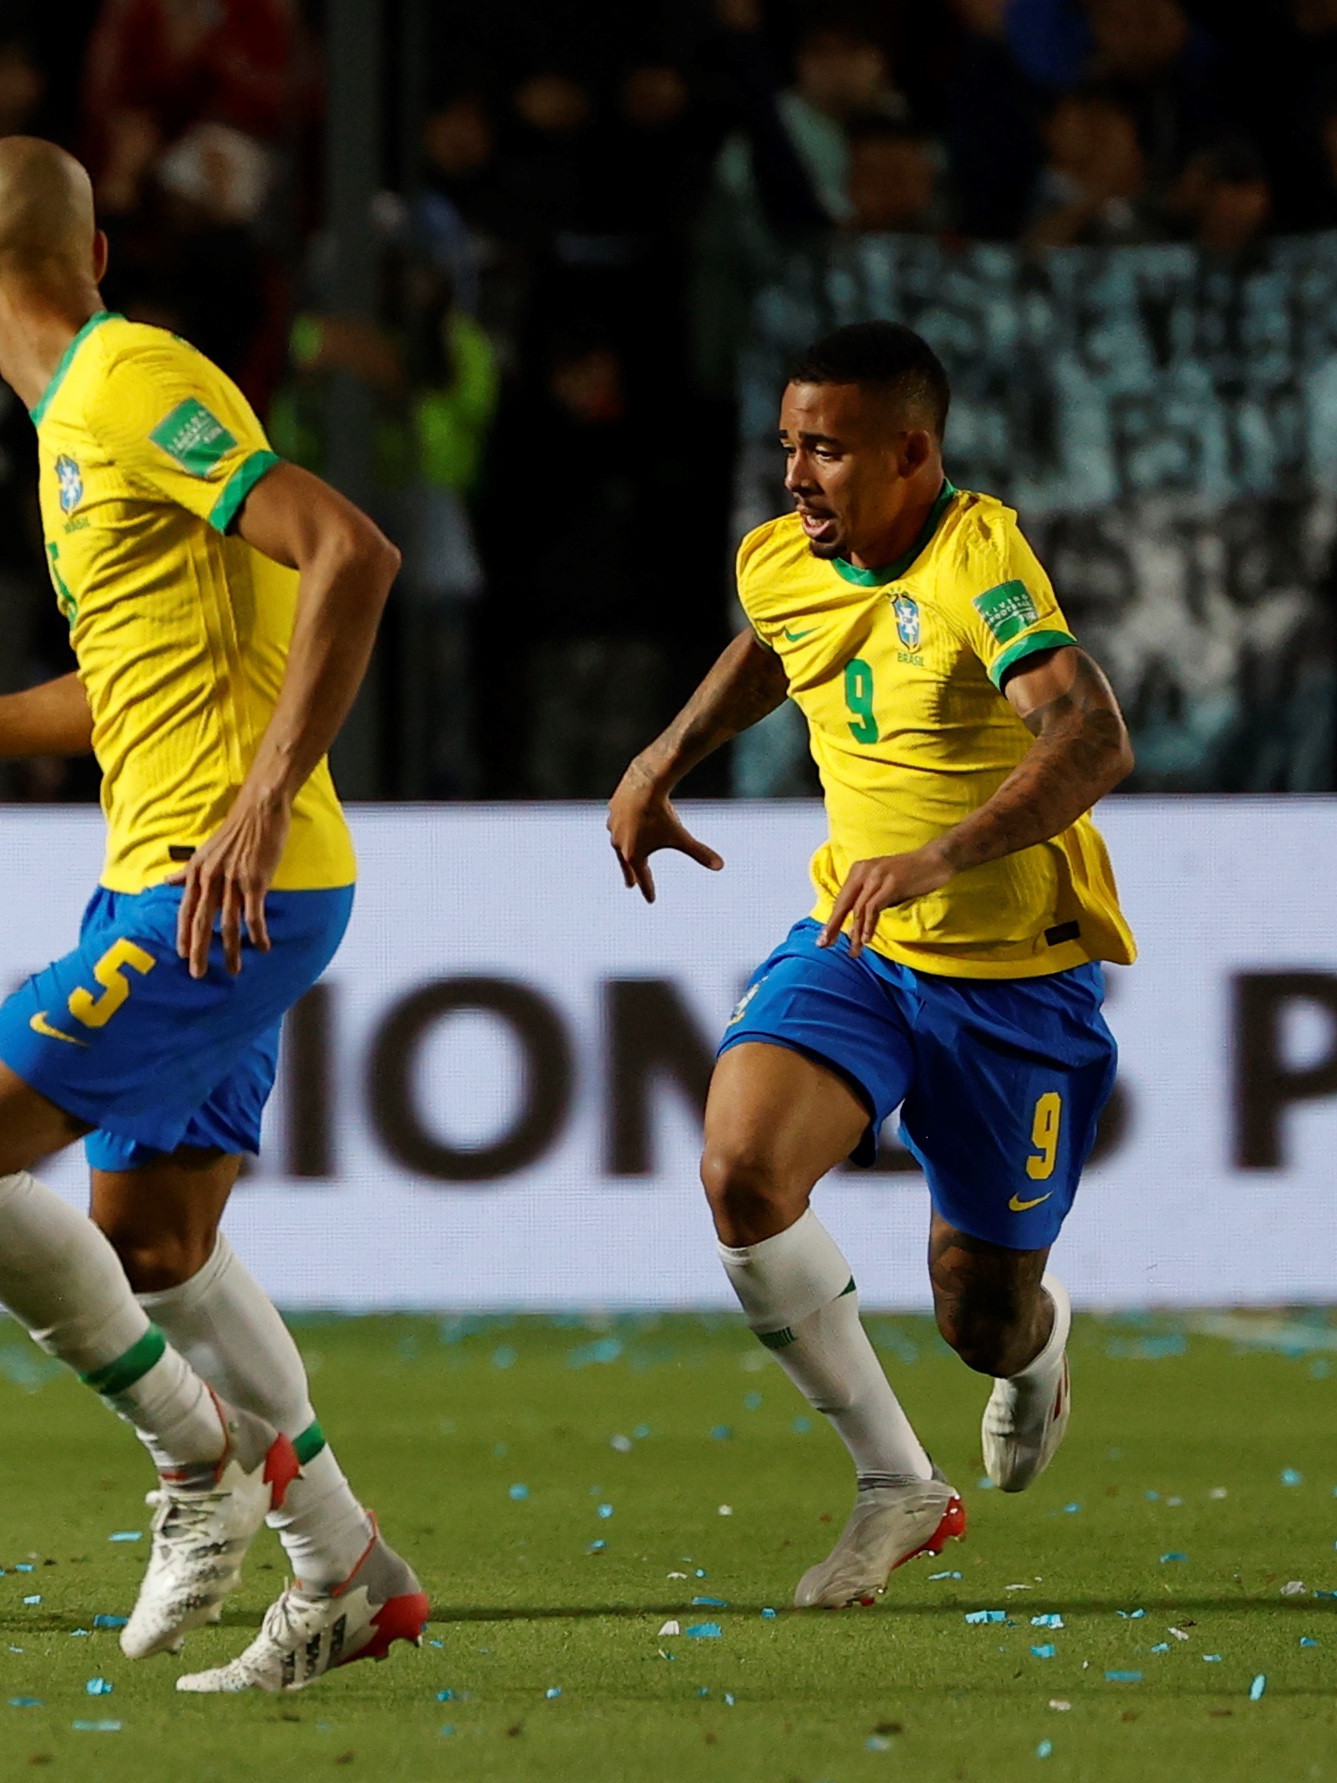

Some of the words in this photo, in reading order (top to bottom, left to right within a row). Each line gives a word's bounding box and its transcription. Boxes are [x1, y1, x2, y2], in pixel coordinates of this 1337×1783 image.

[844, 657, 879, 744] 9
[897, 651, 925, 668] BRASIL
[68, 937, 157, 1028] 5
[1025, 1091, 1062, 1180] 9
